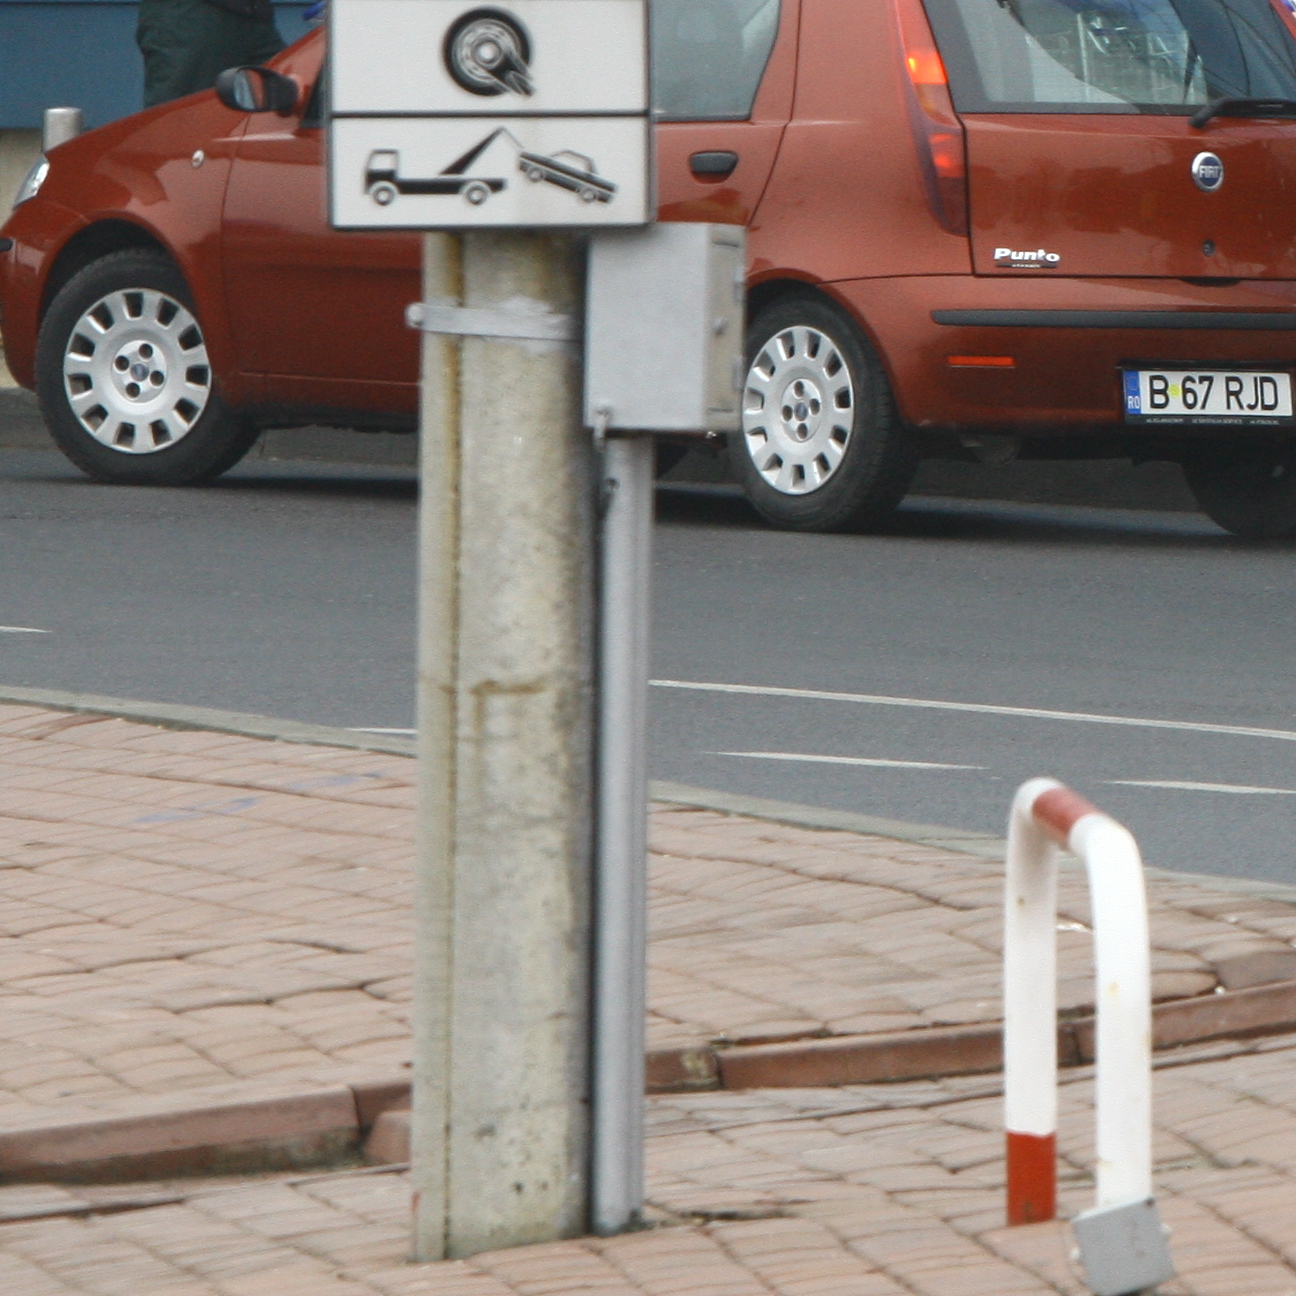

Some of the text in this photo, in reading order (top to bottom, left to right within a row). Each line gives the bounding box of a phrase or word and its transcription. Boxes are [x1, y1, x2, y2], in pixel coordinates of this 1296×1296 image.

[994, 247, 1060, 262] Punto
[1149, 375, 1279, 410] B 67 RJD
[1128, 396, 1140, 409] RO
